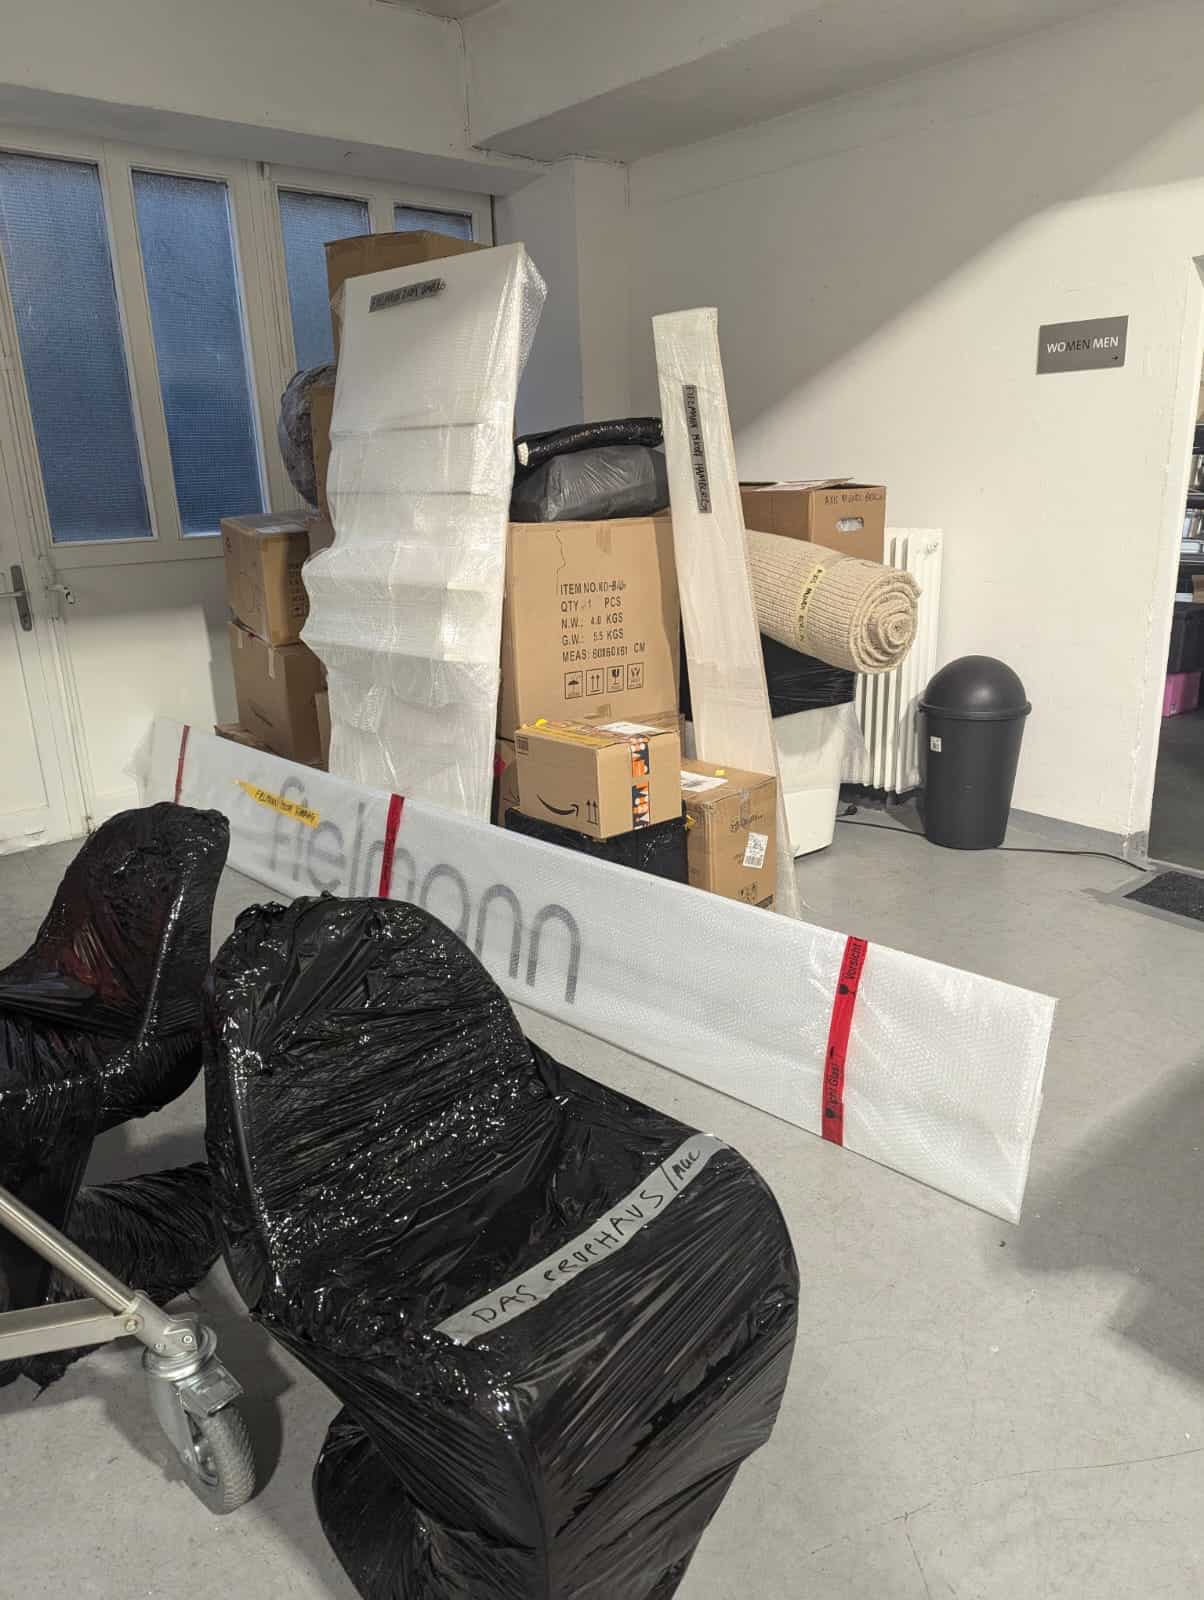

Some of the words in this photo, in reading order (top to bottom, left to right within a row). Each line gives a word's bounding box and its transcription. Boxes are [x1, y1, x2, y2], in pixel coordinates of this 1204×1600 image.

[1046, 339, 1090, 353] WOMEN
[1092, 336, 1119, 349] MEN
[560, 583, 581, 595] ITEM
[604, 596, 621, 608] PCS
[606, 612, 623, 624] KGS
[593, 631, 603, 641] 5.5
[606, 628, 623, 640] KGS
[633, 642, 645, 653] CM
[846, 943, 862, 980] Vorsicht
[471, 1284, 537, 1325] DAS
